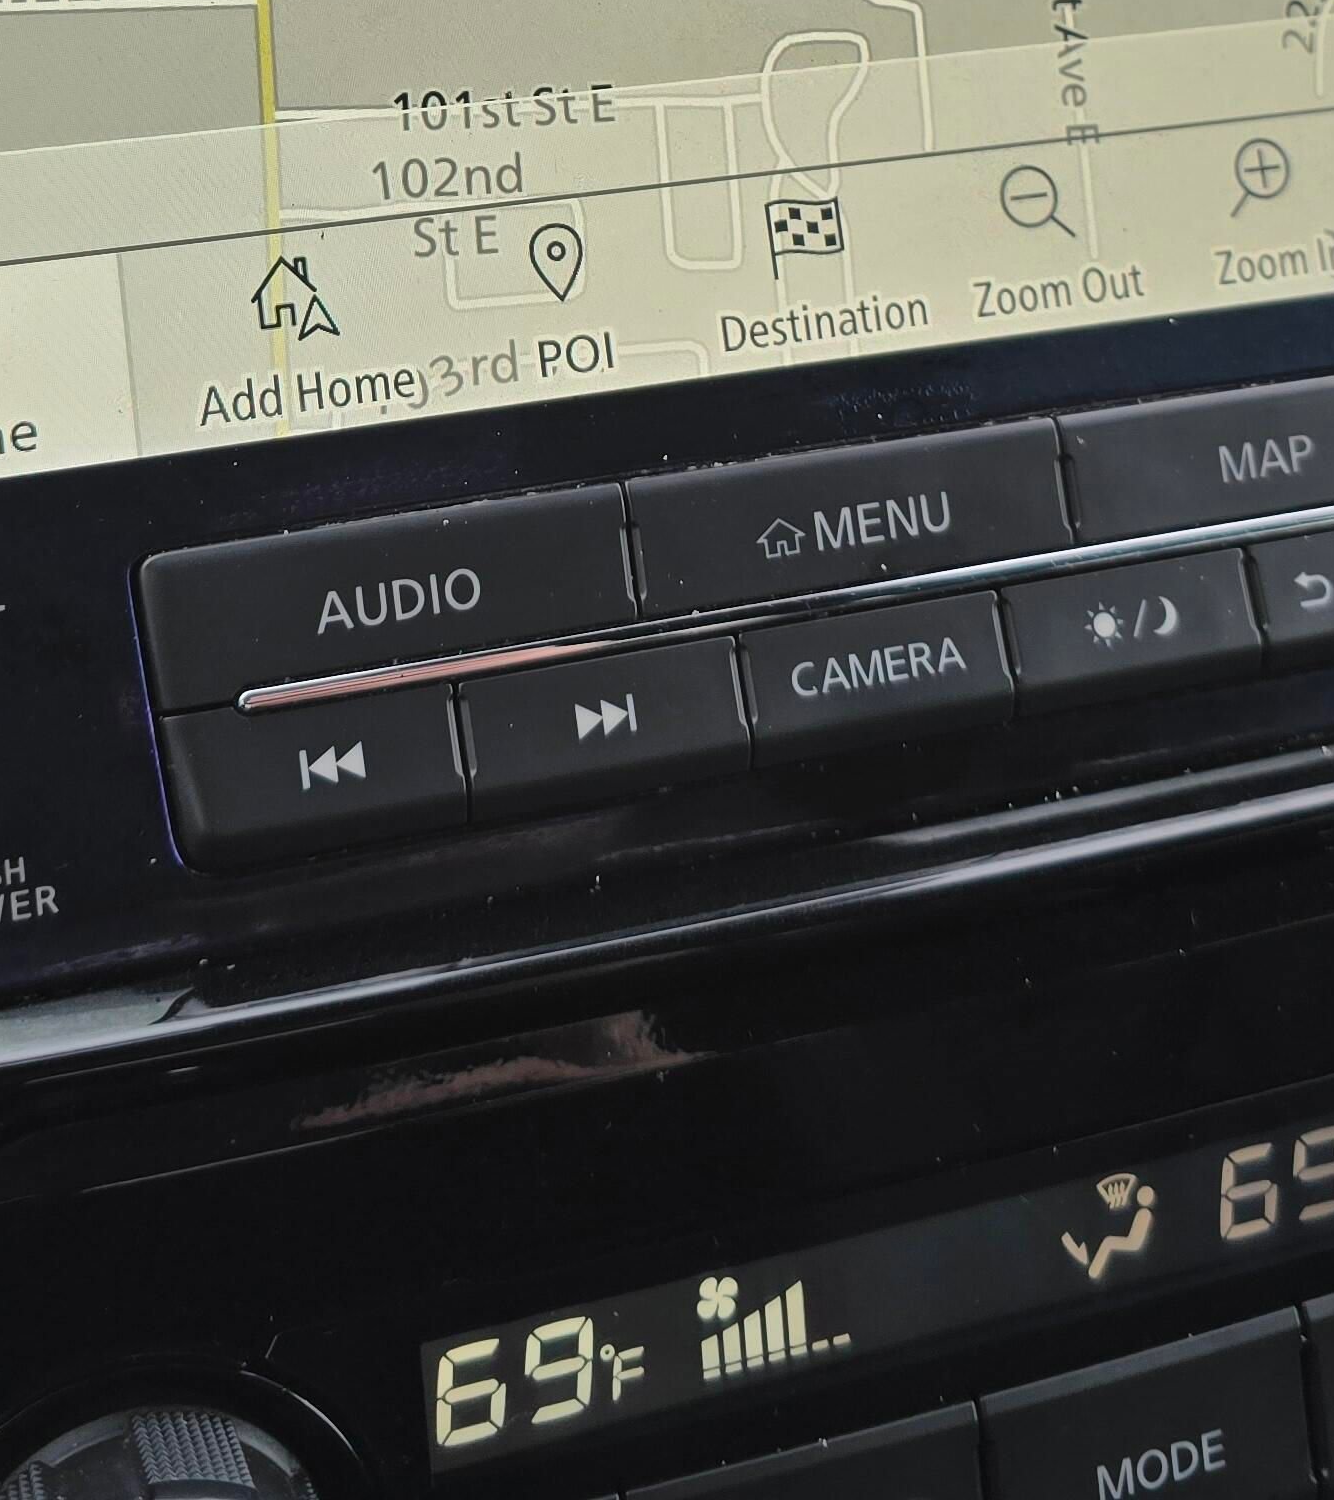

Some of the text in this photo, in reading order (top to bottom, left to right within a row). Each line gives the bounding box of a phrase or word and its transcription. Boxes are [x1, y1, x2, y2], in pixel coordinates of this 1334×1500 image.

[1053, 25, 1089, 108] Ave
[393, 84, 616, 131] 101st St E
[1067, 125, 1098, 145] E
[372, 152, 523, 201] 102nd
[413, 215, 498, 258] St E
[973, 266, 1144, 319] Zoom Out
[1214, 250, 1308, 285] Zoom
[721, 297, 930, 353] Destination
[538, 331, 614, 378] POI
[200, 367, 416, 426] Add Home
[1217, 435, 1315, 485] MAP
[813, 493, 952, 553] MENU
[316, 568, 482, 635] AUDIO
[790, 636, 966, 700] CAMERA
[1097, 1429, 1226, 1500] MODE
